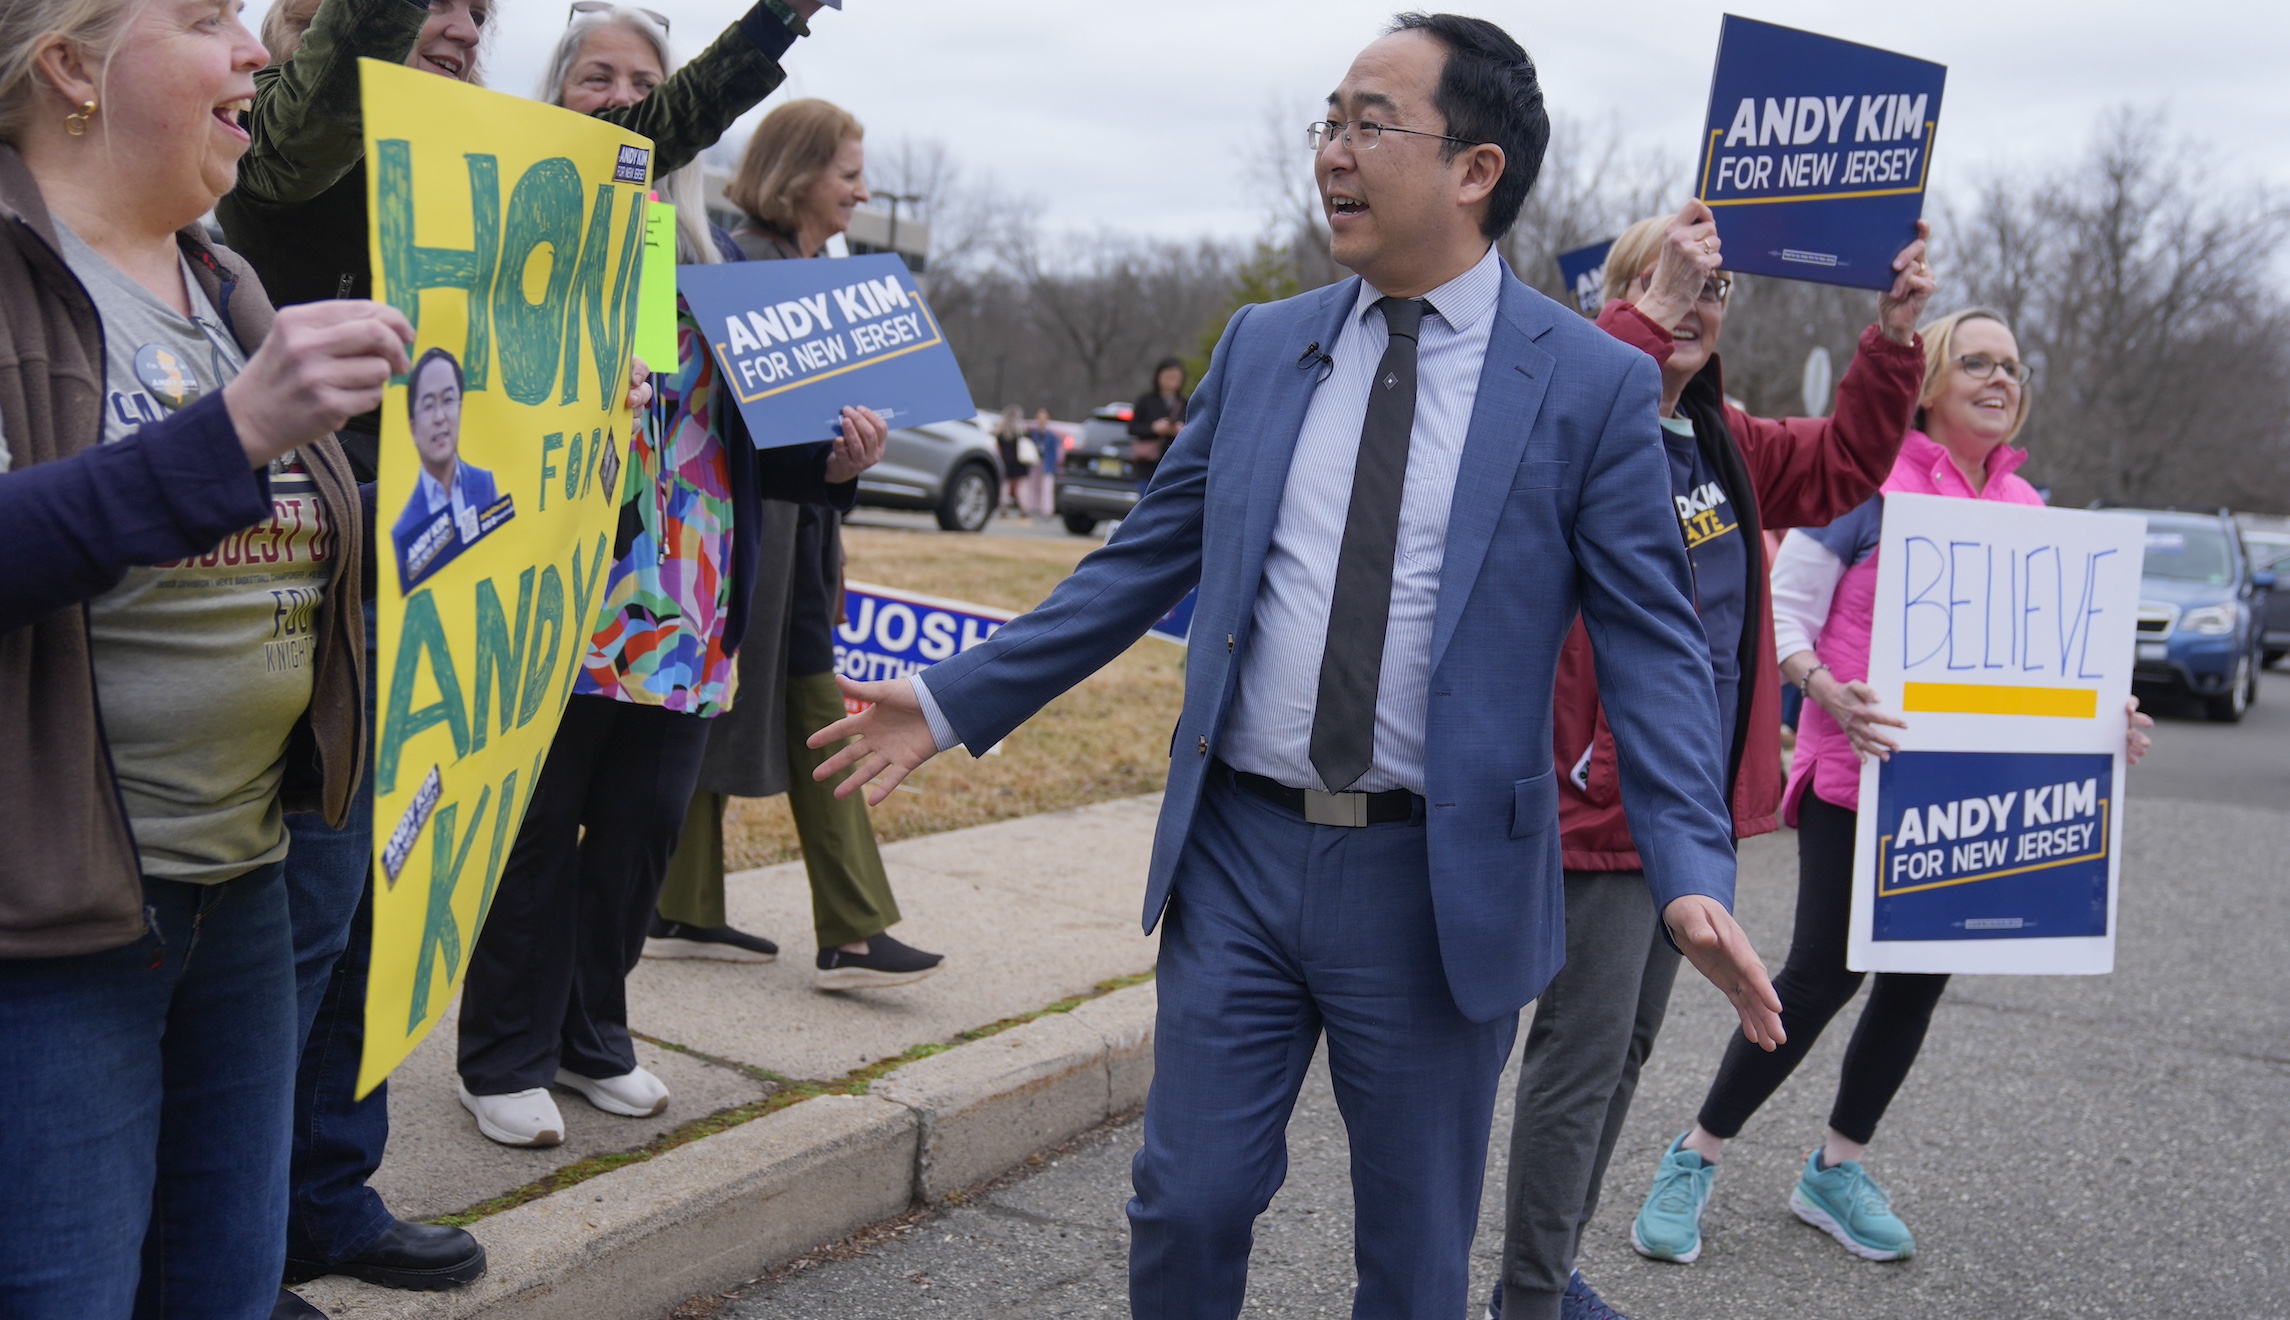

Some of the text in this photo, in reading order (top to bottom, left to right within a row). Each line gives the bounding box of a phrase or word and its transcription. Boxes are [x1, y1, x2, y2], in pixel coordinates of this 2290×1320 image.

[1724, 93, 1929, 148] ANDY KIM
[619, 146, 649, 167] ANDY KIM
[1716, 147, 1919, 192] FOR NEW JERSEY
[375, 138, 645, 417] HON
[725, 274, 911, 356] ANDY KIM
[738, 311, 922, 389] FOR NEW JERSEY
[539, 426, 602, 512] FOR
[1683, 509, 1726, 541] ATE
[269, 587, 319, 639] FDU
[1903, 536, 2118, 679] BELIEVE
[374, 530, 607, 797] ANDY
[385, 799, 416, 865] ANDY
[1894, 778, 2098, 849] ANDY KIM
[1892, 822, 2095, 884] FOR NEW JERSEY
